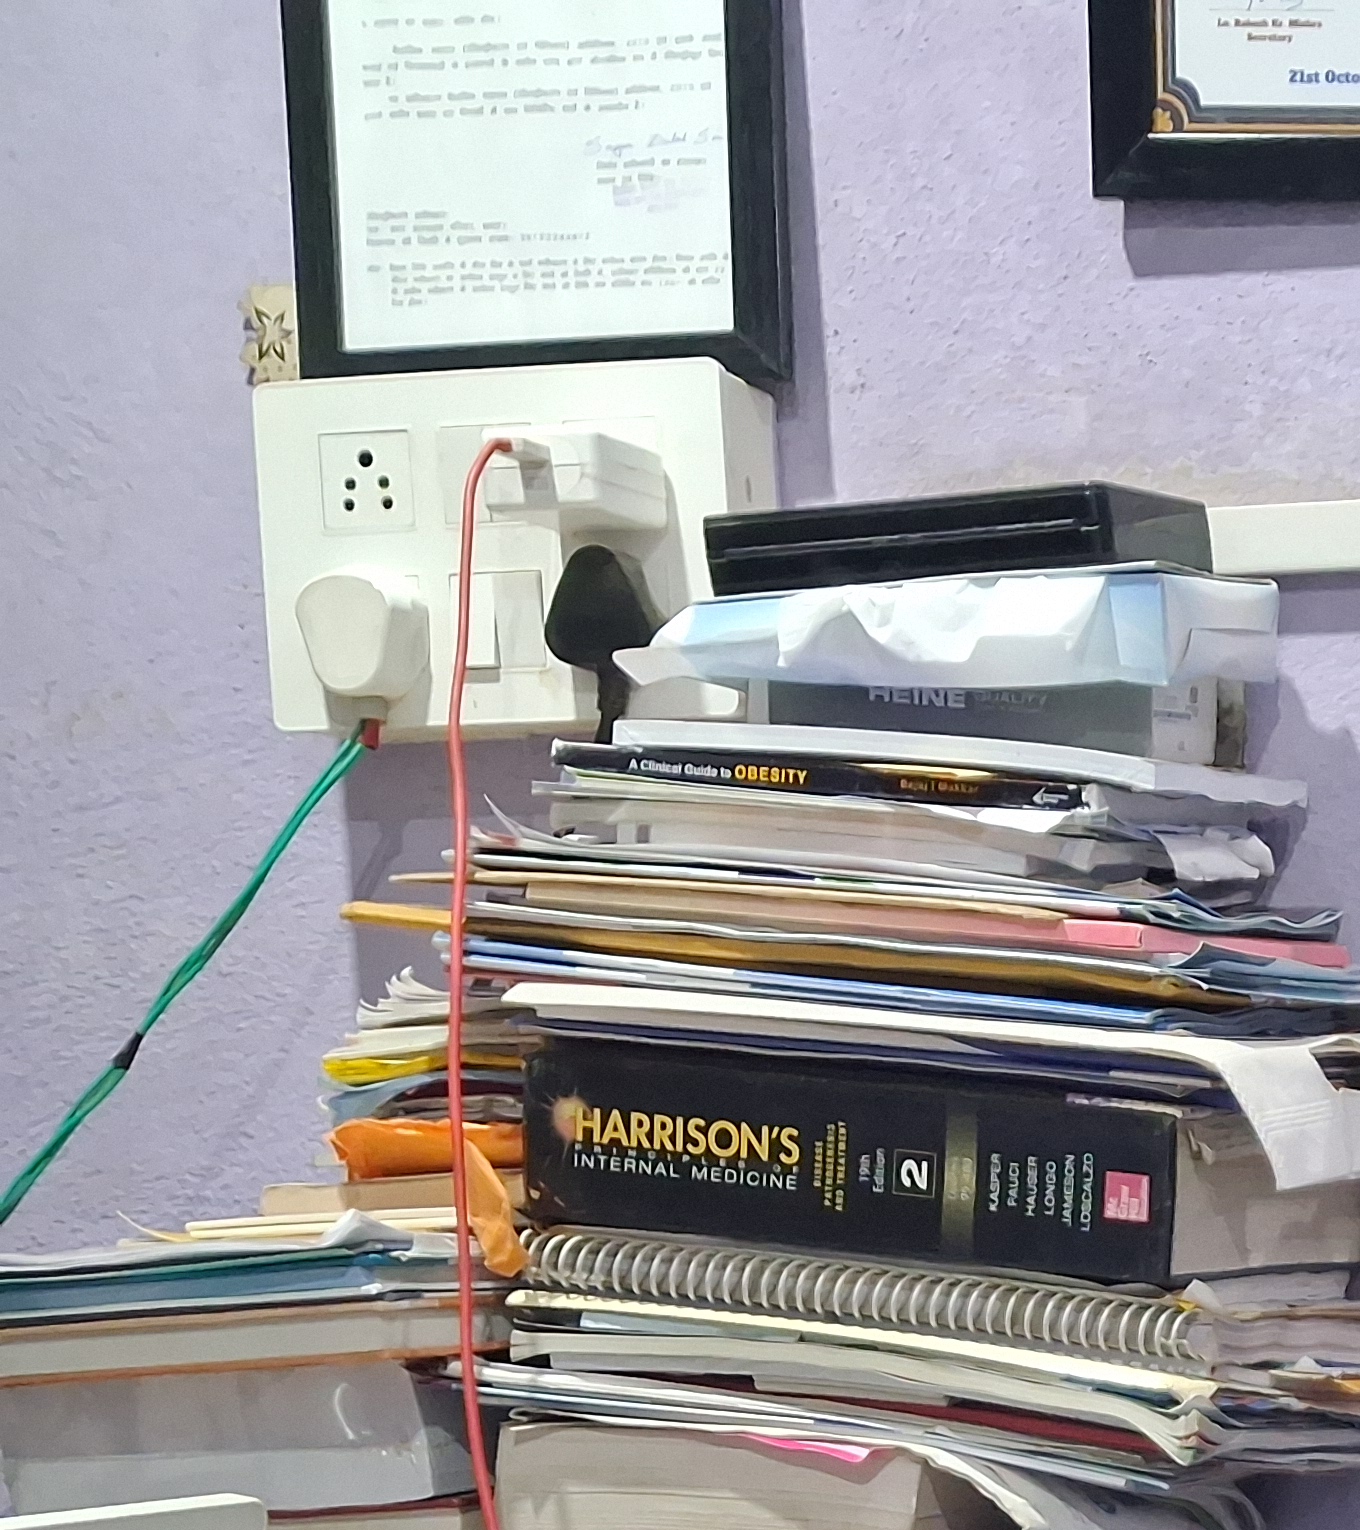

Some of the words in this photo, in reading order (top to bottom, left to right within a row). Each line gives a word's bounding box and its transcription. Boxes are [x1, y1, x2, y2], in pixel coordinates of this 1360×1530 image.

[1288, 69, 1320, 84] 21st
[868, 686, 966, 708] HEINE
[628, 759, 639, 771] A
[640, 760, 682, 775] Clinical
[684, 763, 718, 778] Guide
[720, 767, 732, 779] to
[734, 765, 807, 785] OBESITY
[574, 1107, 800, 1166] HARRISON'S
[836, 1121, 848, 1185] TREATMENT
[573, 1153, 680, 1179] INTERNAL
[691, 1165, 798, 1191] MEDICINE
[812, 1140, 824, 1188] DISEASE
[858, 1154, 872, 1183] 19th
[872, 1147, 886, 1194] Edition
[900, 1158, 929, 1191] 2
[988, 1153, 1001, 1213] KASPER
[1007, 1162, 1020, 1208] FAUCI
[1024, 1155, 1038, 1217] HAUSER
[835, 1189, 845, 1212] AND
[1044, 1161, 1057, 1216] LONGO
[1061, 1154, 1076, 1227] JAMESON
[1080, 1152, 1094, 1232] LOSCALZO
